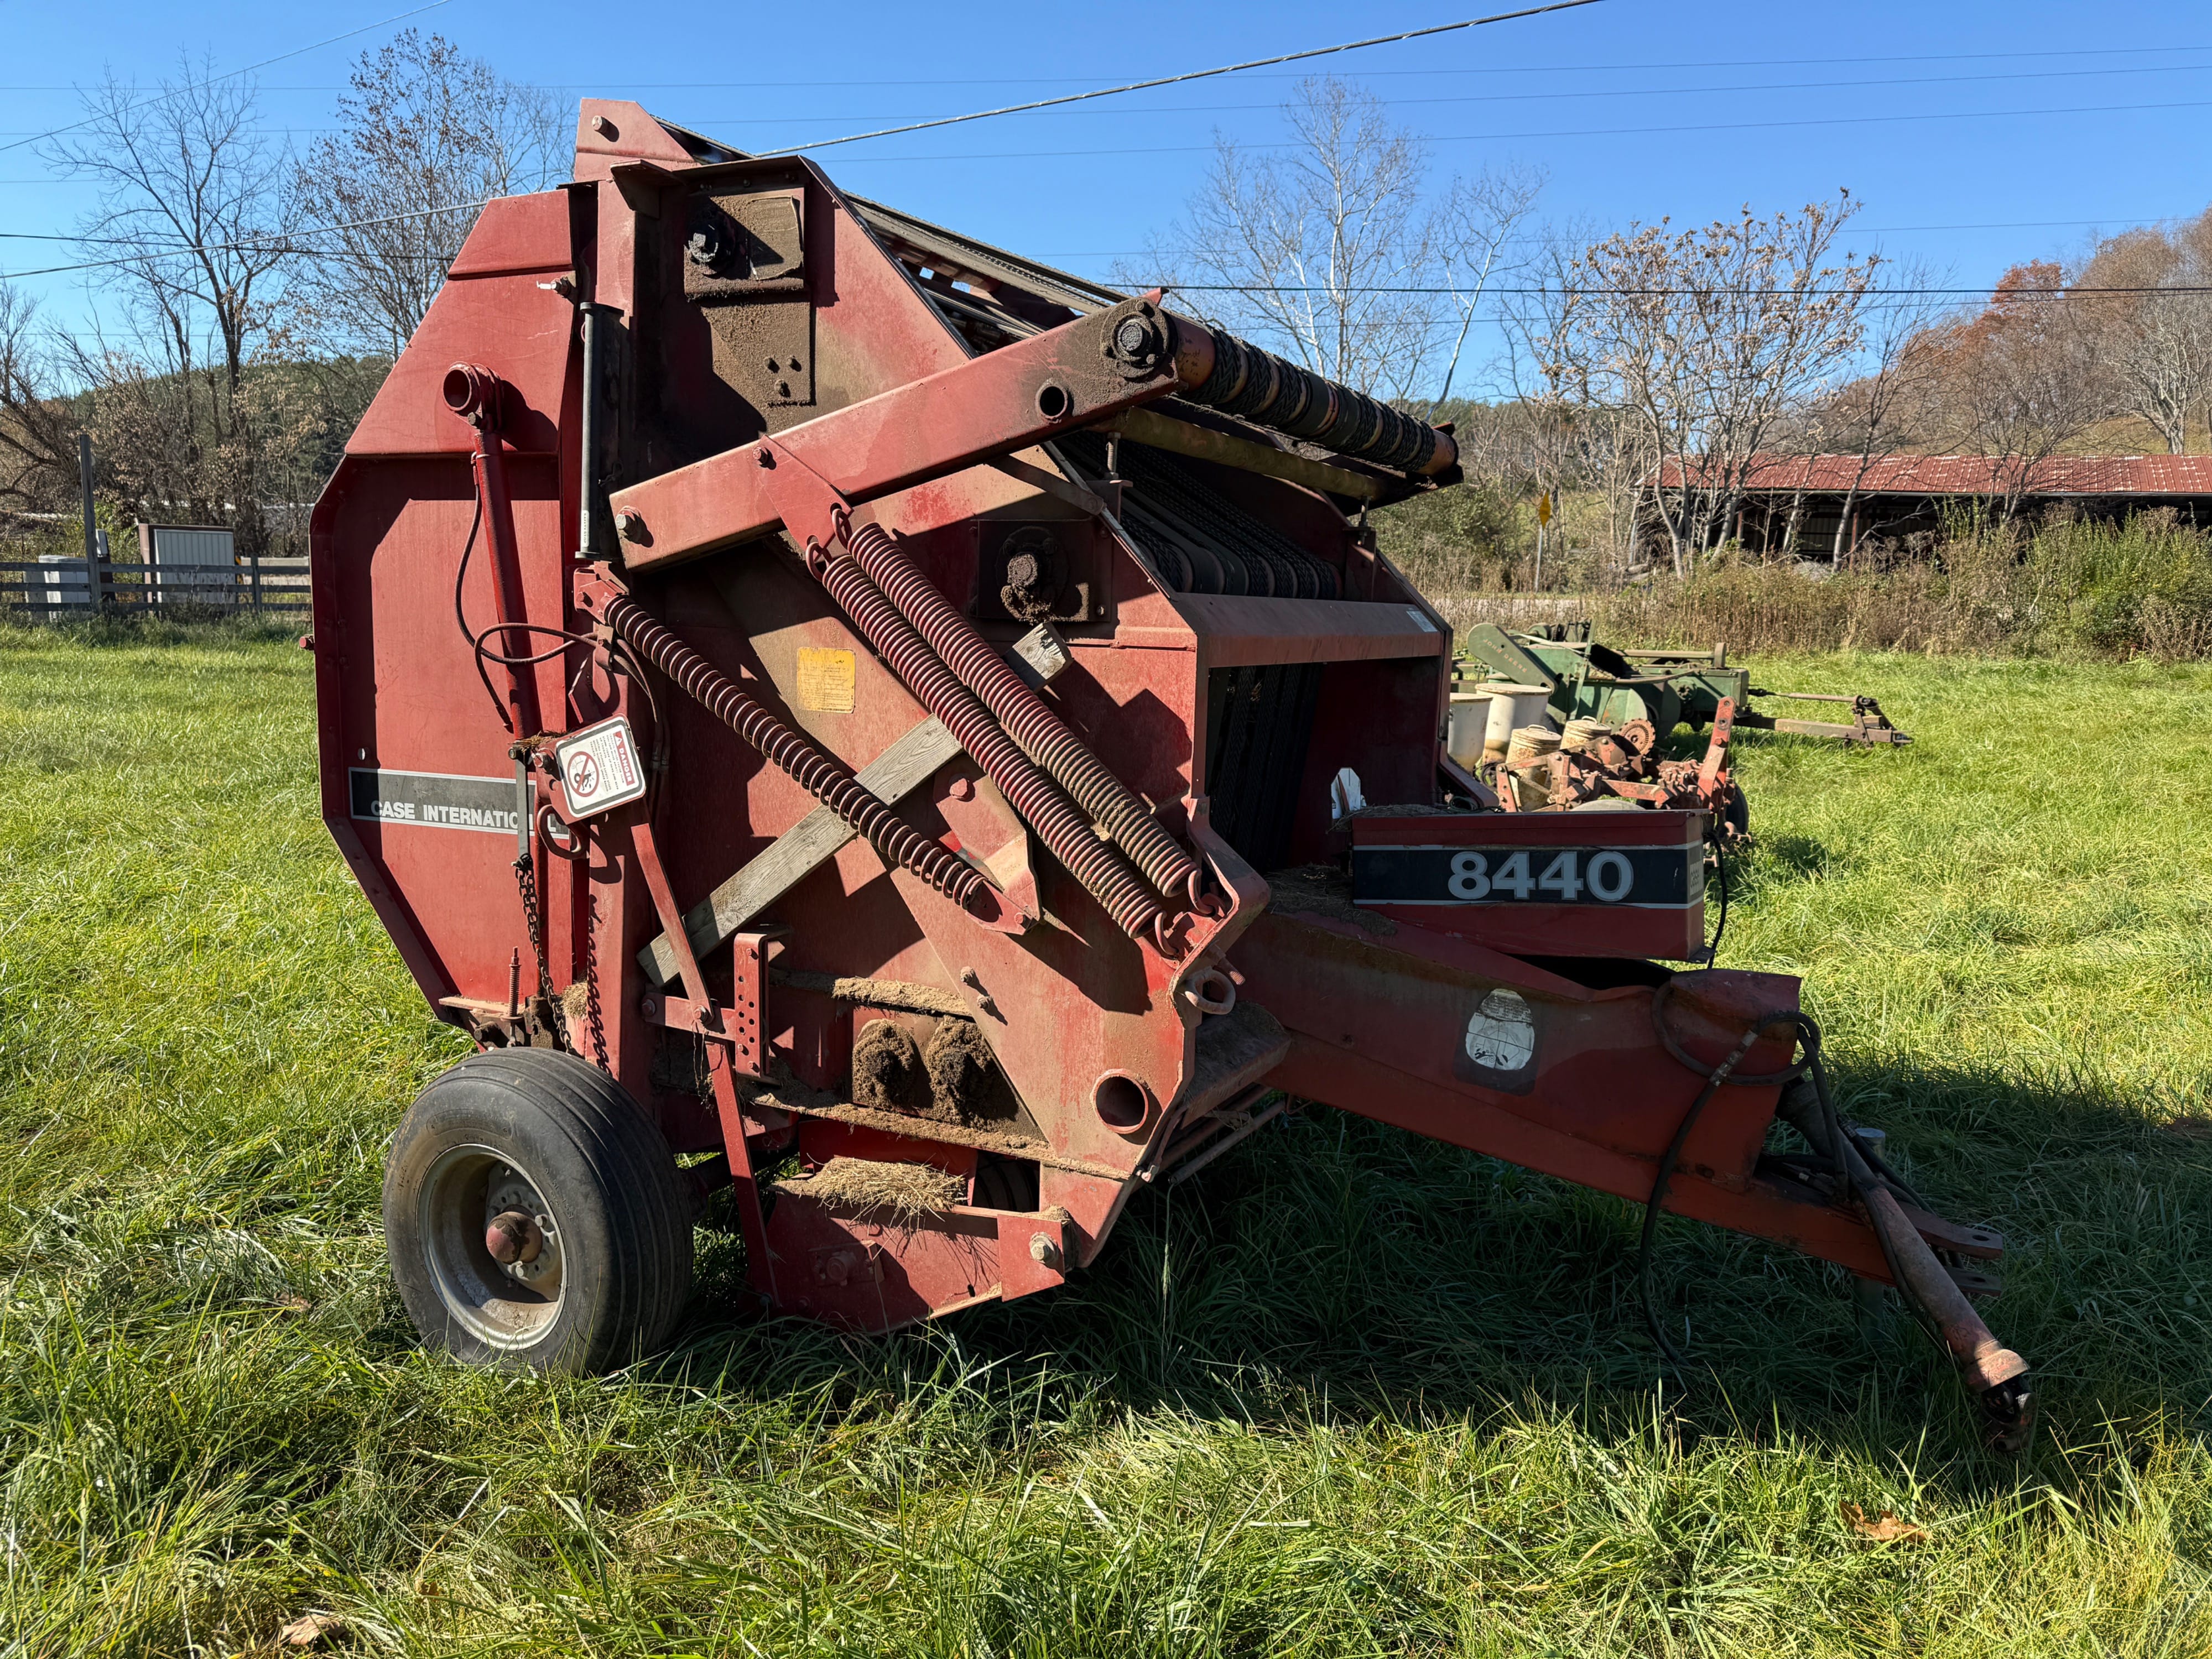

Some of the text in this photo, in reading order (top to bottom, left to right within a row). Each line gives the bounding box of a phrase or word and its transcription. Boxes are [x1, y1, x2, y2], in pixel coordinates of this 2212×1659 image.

[1483, 639, 1527, 672] JOHN DEERE
[619, 748, 632, 782] DANGER
[371, 800, 556, 832] CASE INTERNATIOL
[1448, 851, 1634, 902] 8440
